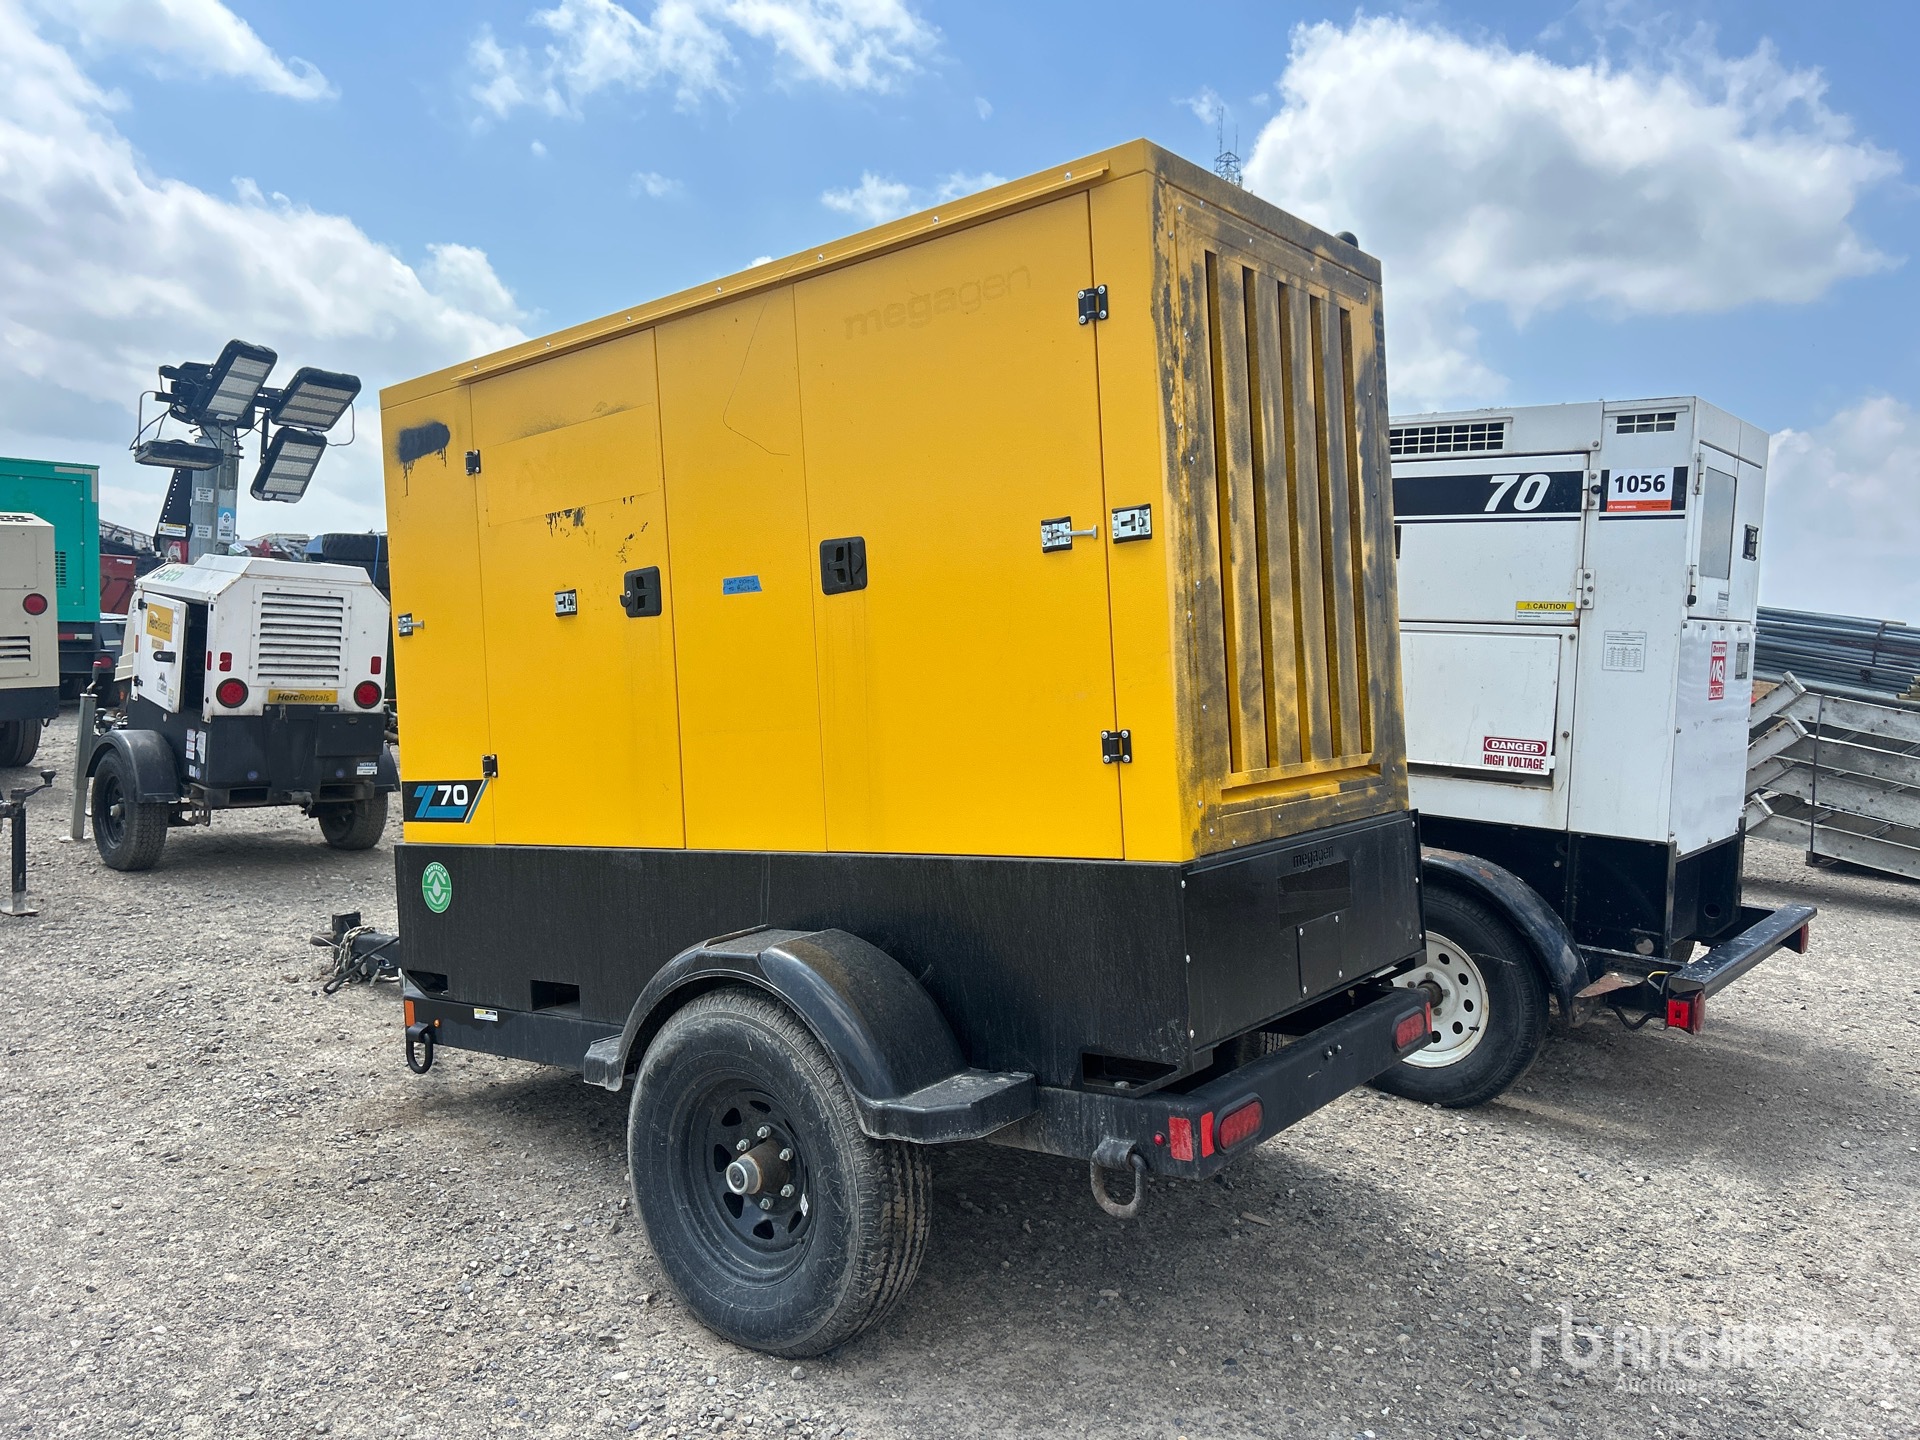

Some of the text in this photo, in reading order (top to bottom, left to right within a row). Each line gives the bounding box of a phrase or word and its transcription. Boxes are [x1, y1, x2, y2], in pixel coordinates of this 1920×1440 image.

[843, 265, 1031, 340] megagen
[1484, 474, 1550, 512] 70
[1614, 474, 1666, 493] 1056
[1533, 602, 1567, 610] CAUTION
[1491, 740, 1539, 752] DANGER
[1484, 754, 1545, 770] HIGH VOLTAGE
[1292, 845, 1334, 868] megagen
